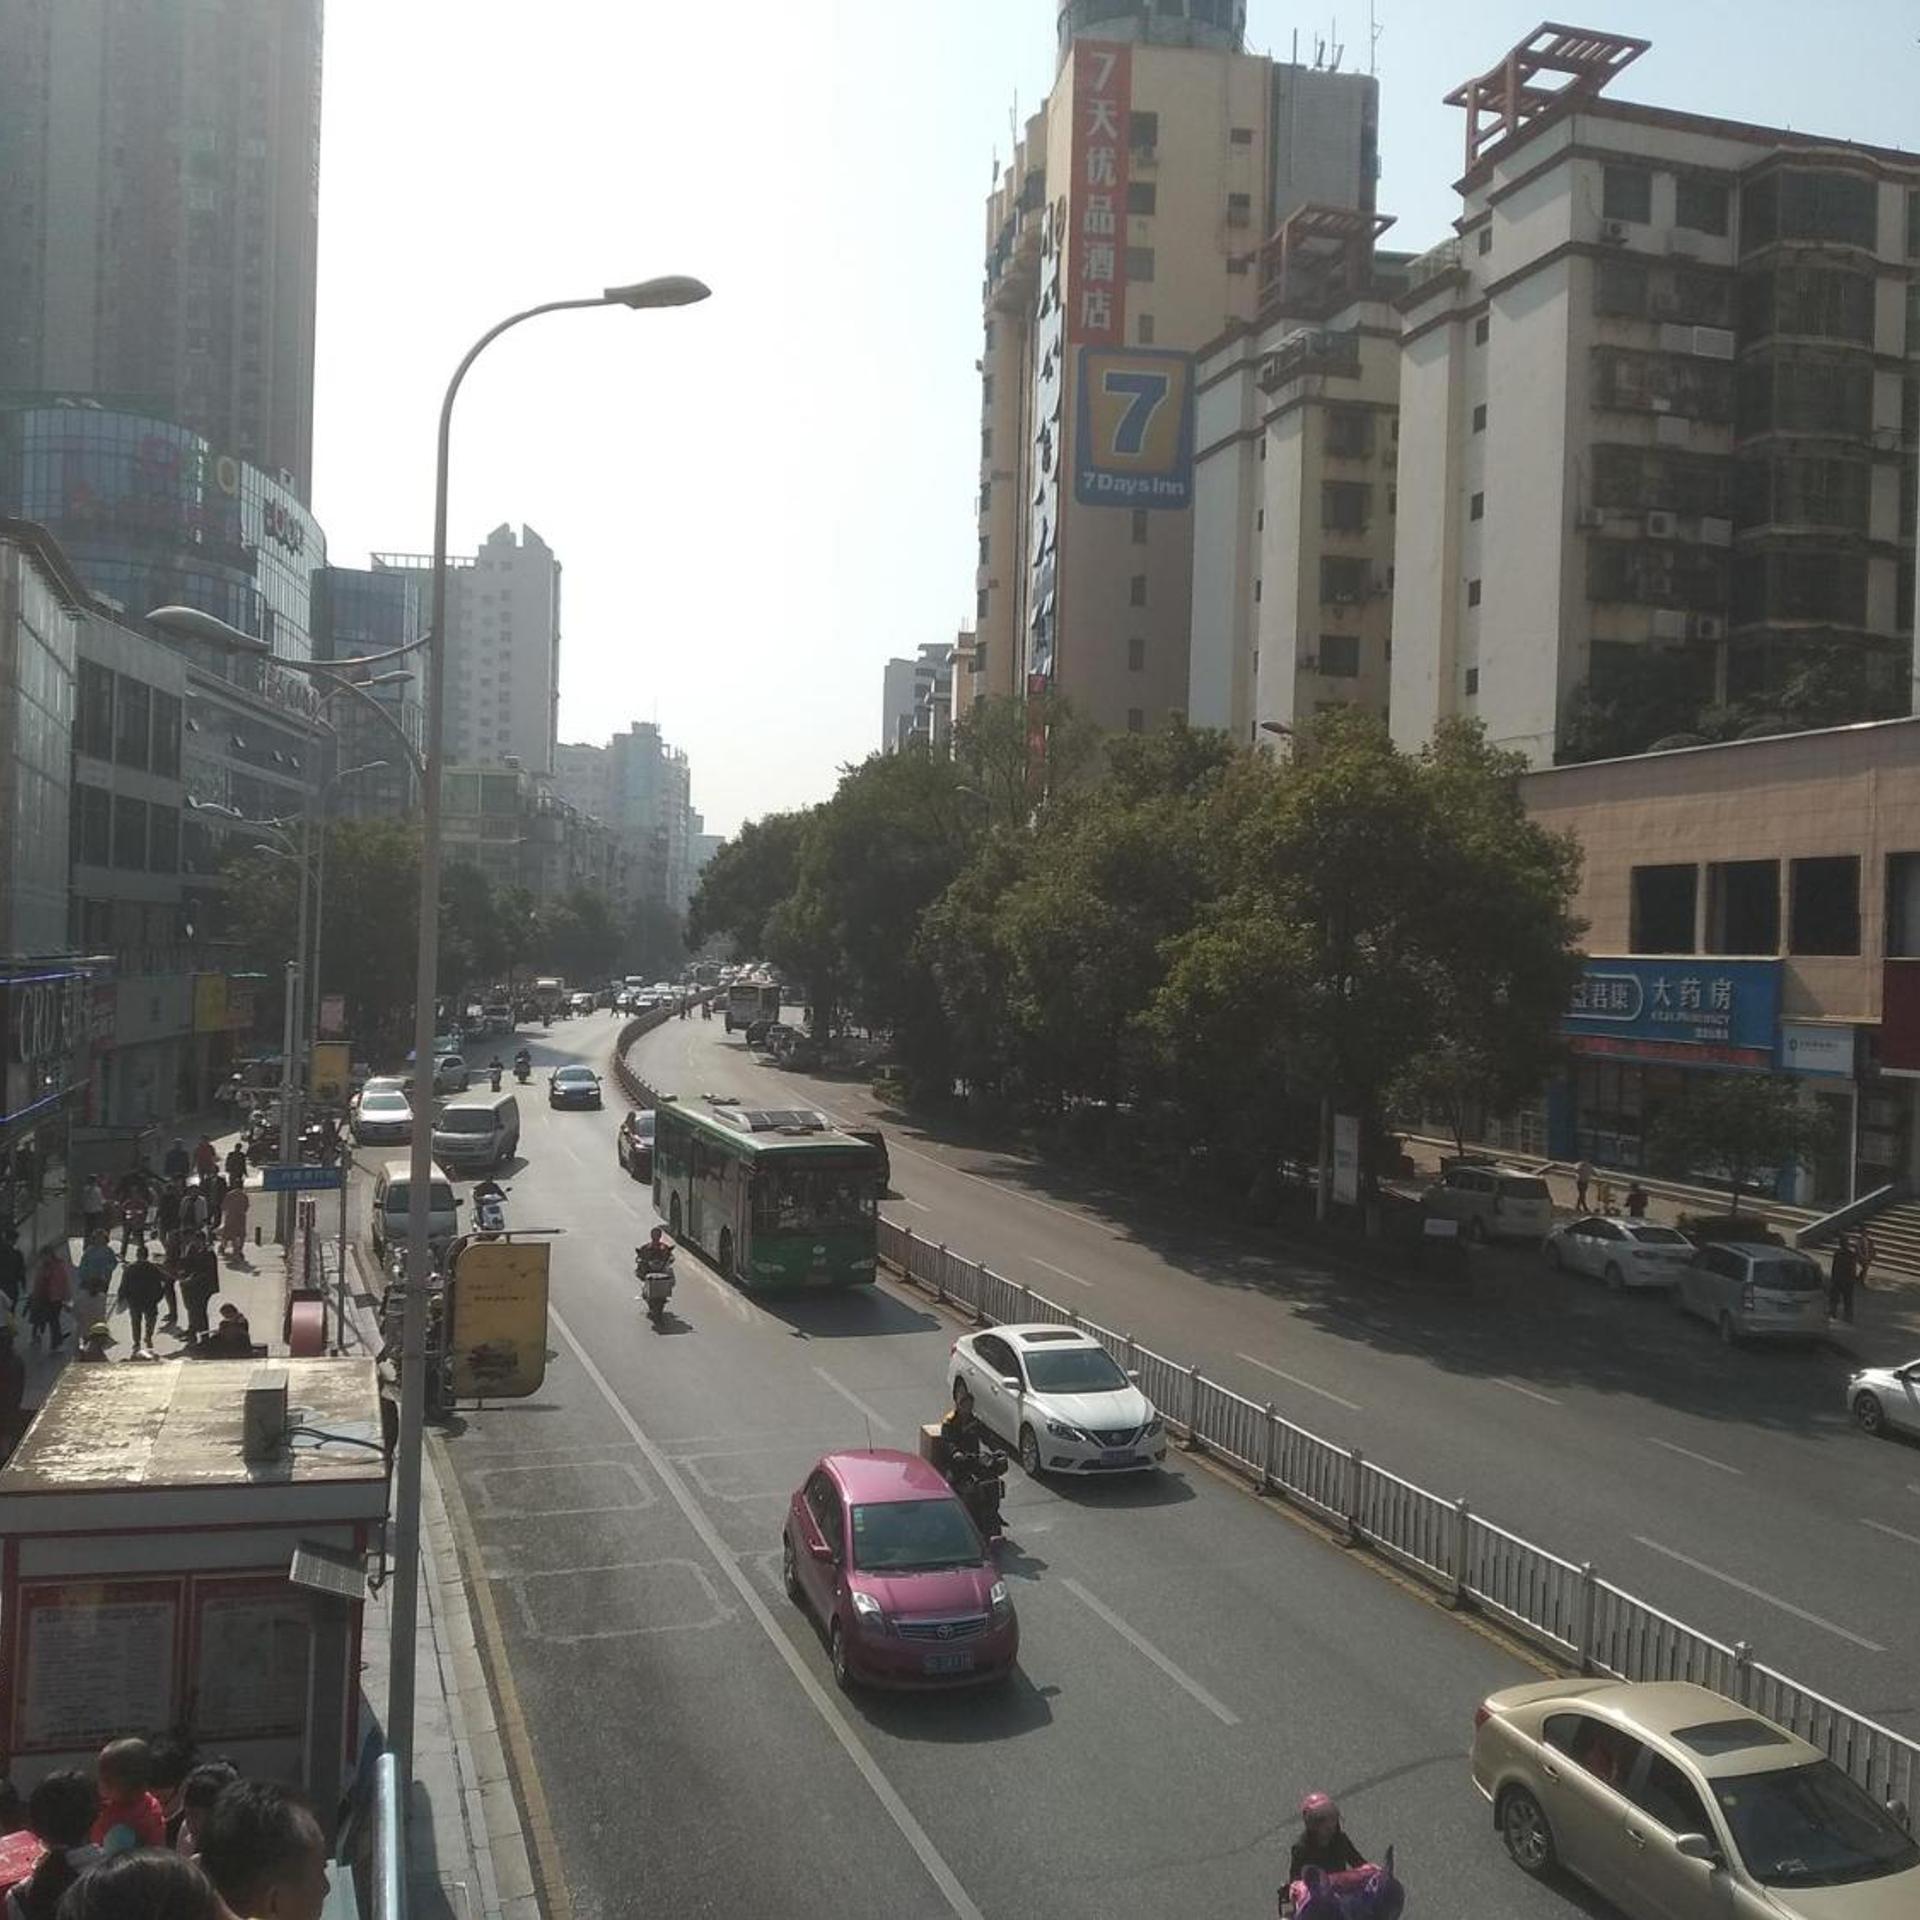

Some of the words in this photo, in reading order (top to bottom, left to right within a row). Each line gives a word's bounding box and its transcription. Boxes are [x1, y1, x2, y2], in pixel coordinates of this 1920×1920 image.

[1081, 51, 1118, 331] 7天优品酒店
[1102, 368, 1171, 457] 7
[1153, 477, 1185, 495] Inn
[1651, 976, 1735, 1010] 大药房
